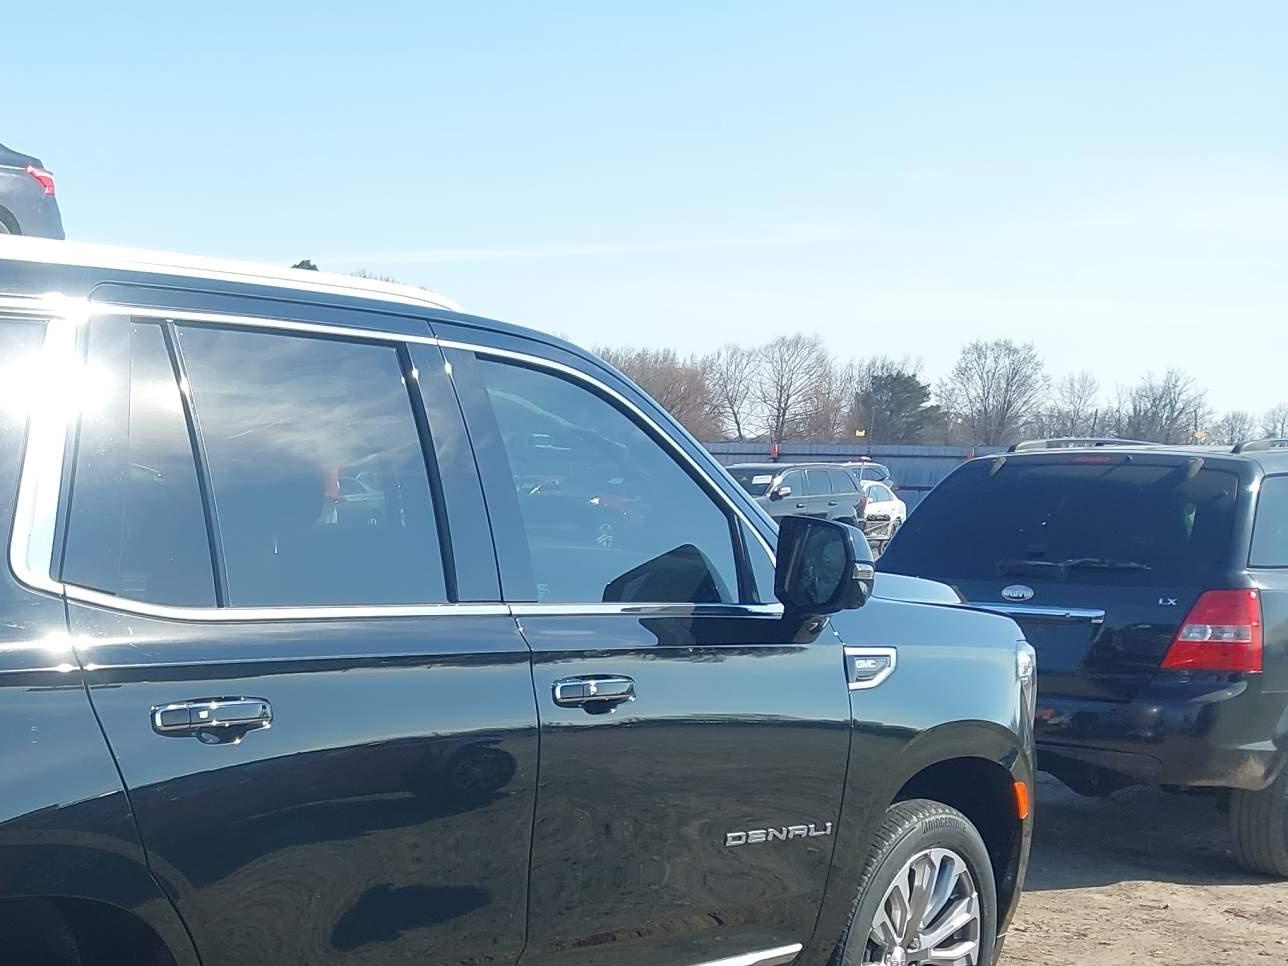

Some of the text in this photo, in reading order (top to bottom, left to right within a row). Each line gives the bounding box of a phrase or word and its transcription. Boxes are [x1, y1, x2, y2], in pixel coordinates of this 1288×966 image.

[1158, 598, 1178, 606] LX
[856, 659, 877, 669] GMC
[725, 822, 832, 847] DENALI
